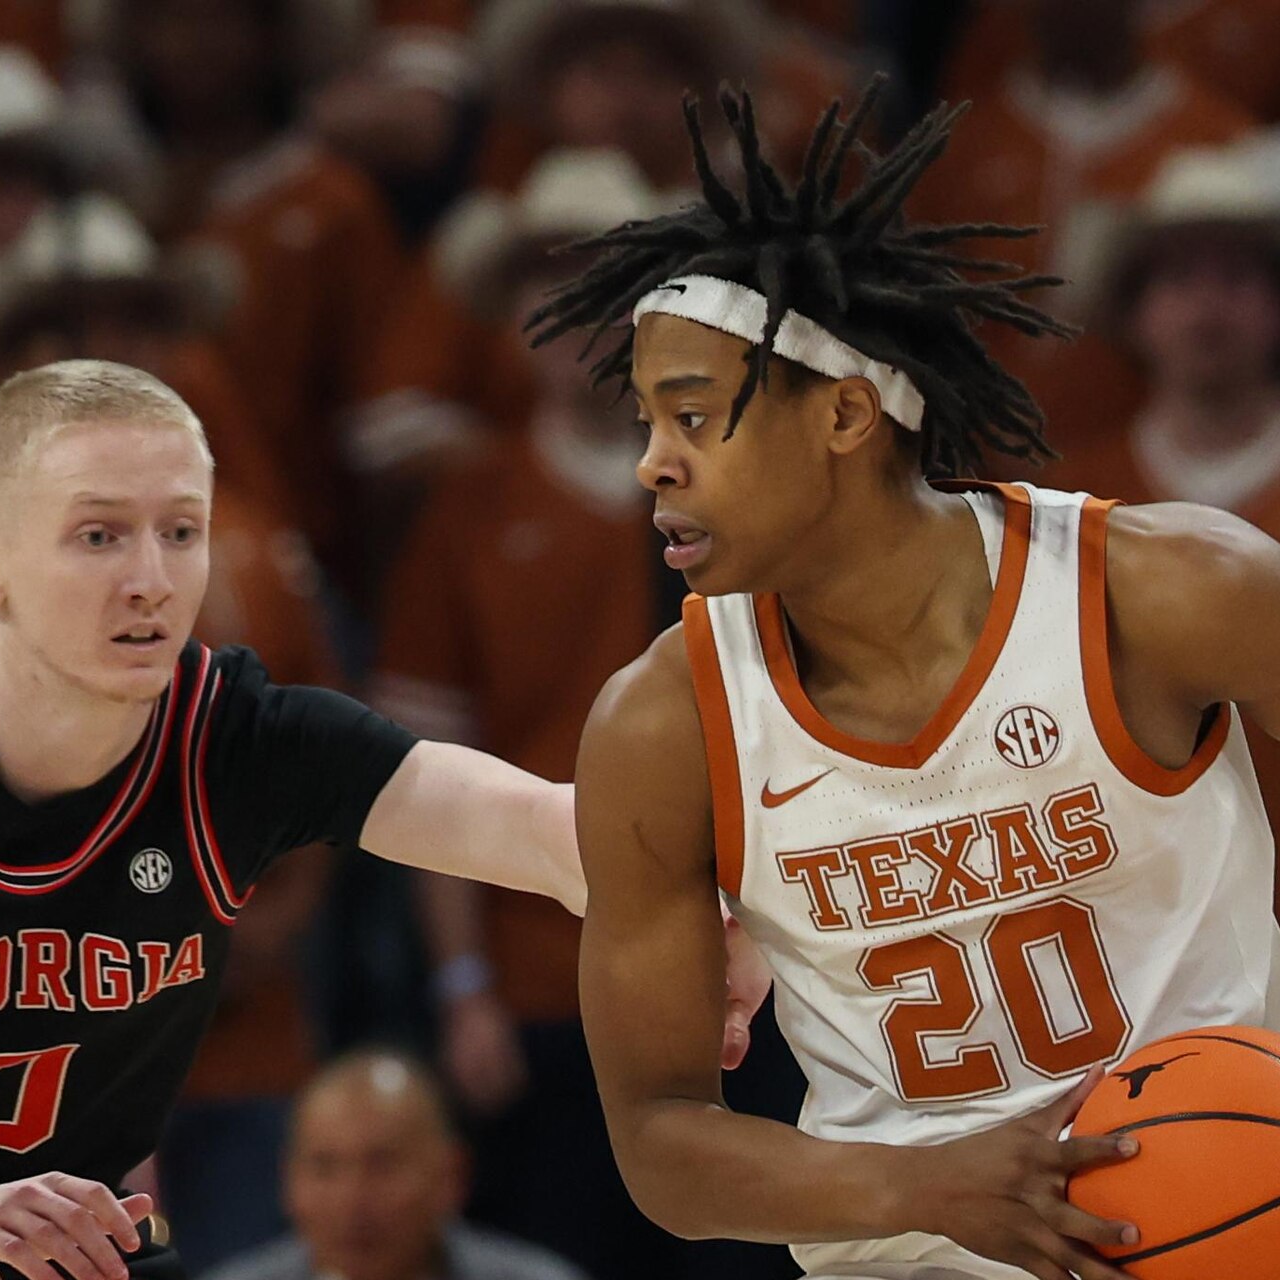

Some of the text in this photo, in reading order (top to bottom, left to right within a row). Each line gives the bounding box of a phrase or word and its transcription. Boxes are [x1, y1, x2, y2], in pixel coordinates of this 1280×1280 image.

[996, 707, 1059, 767] SEC
[133, 851, 170, 891] SEC
[776, 782, 1119, 932] TEXAS
[856, 895, 1133, 1104] 20
